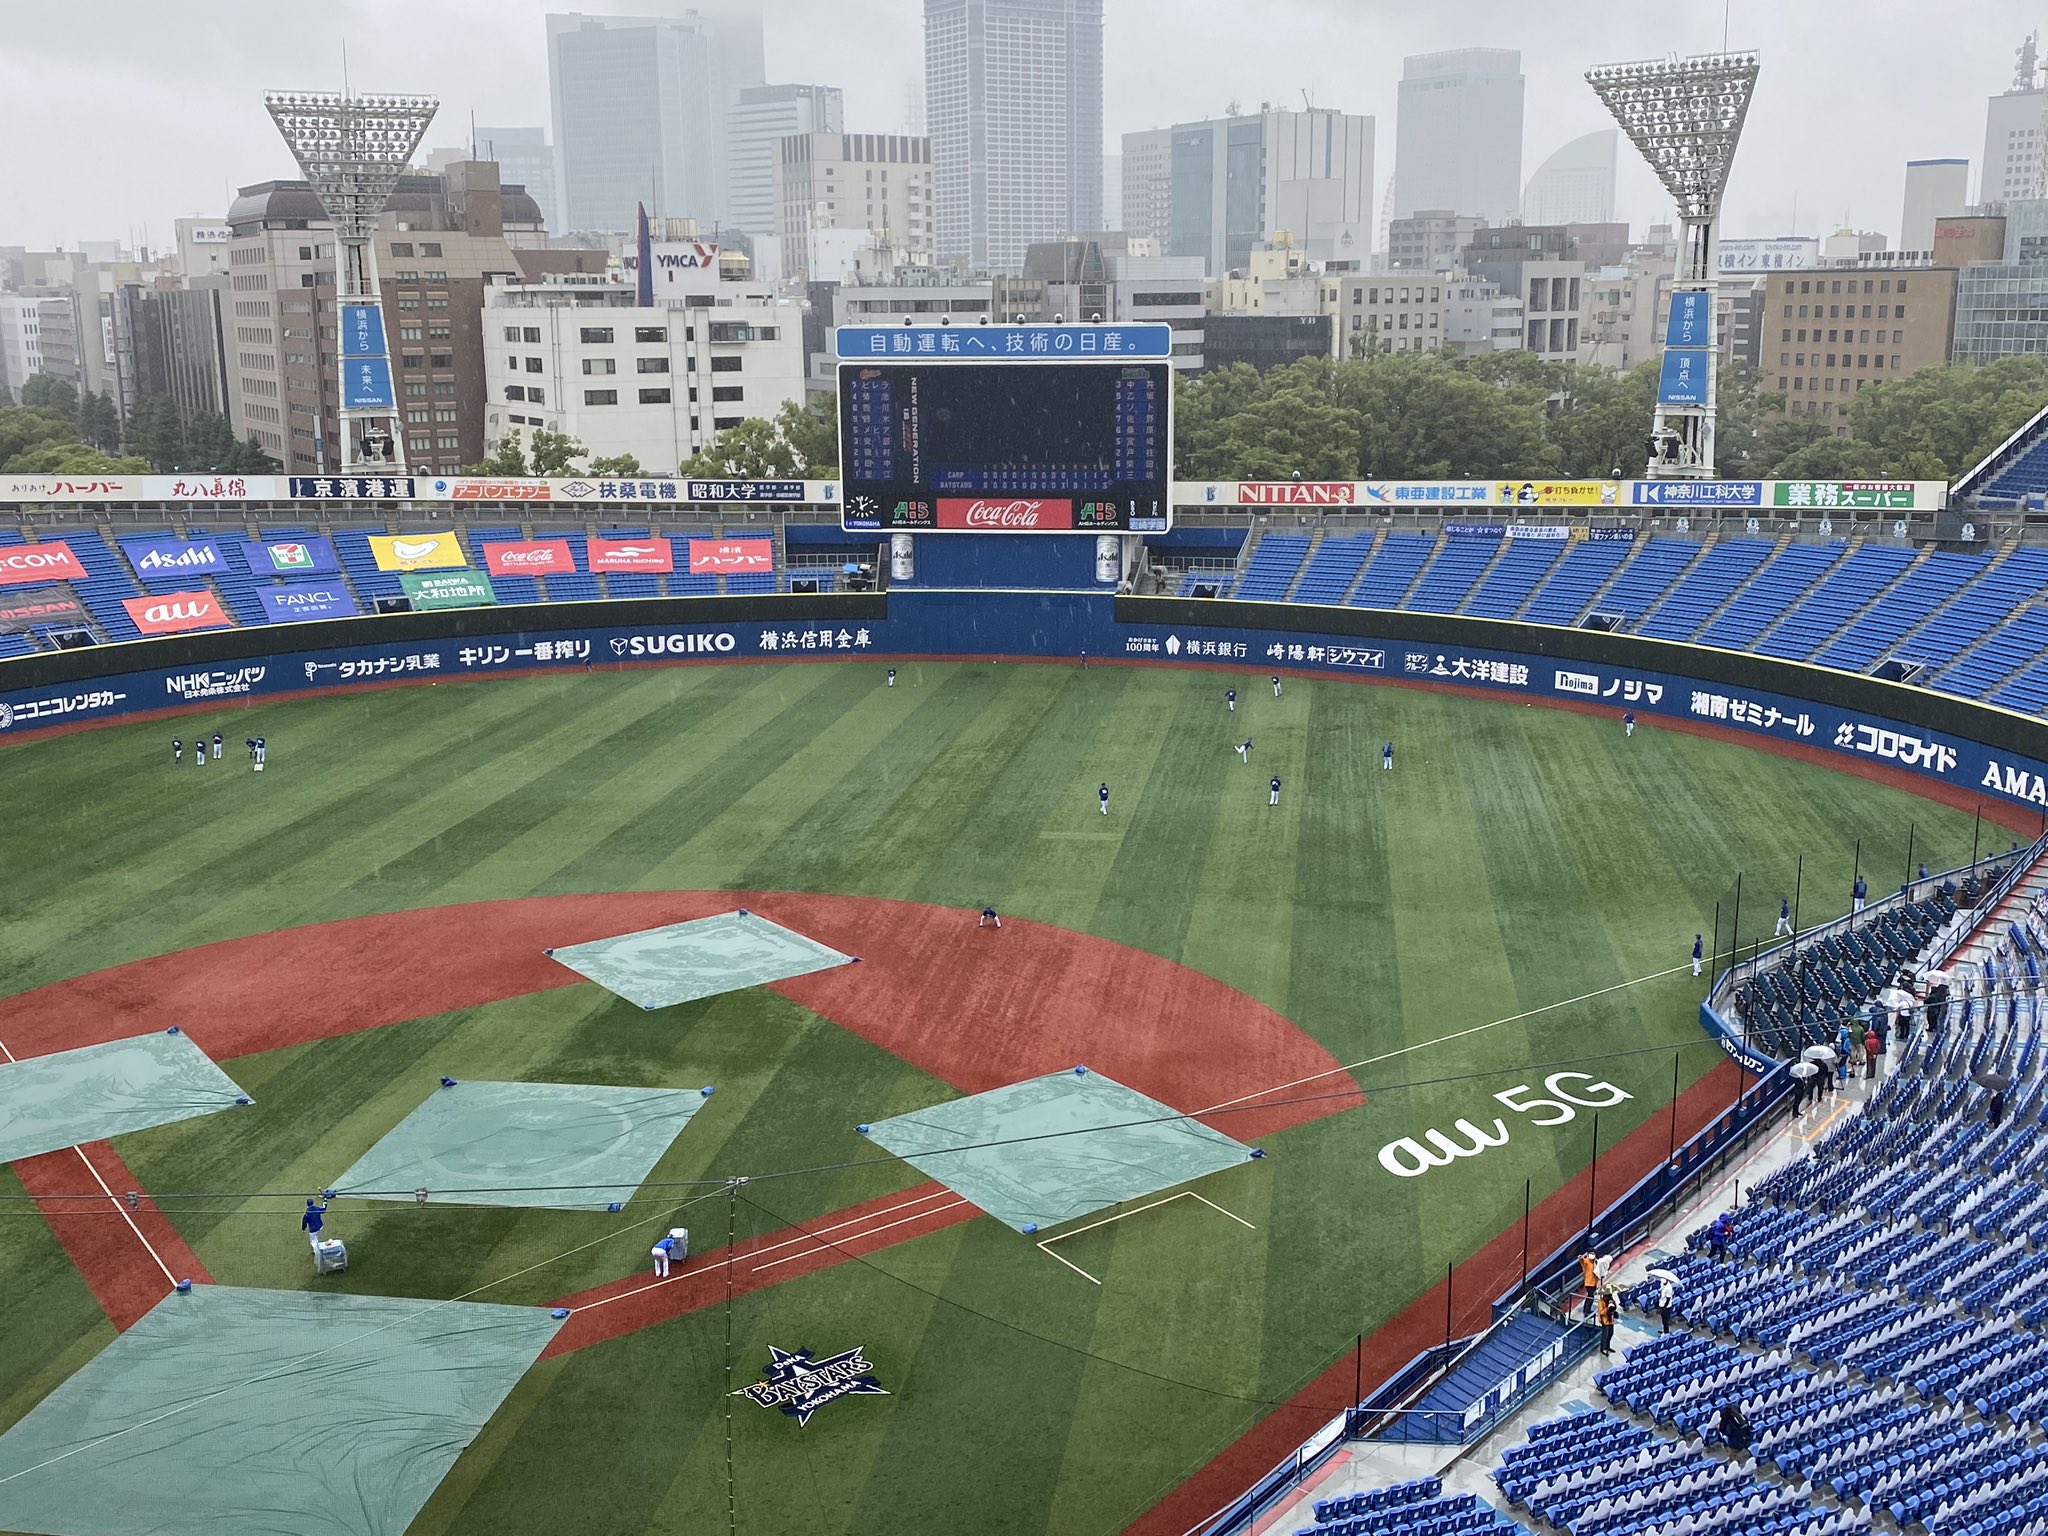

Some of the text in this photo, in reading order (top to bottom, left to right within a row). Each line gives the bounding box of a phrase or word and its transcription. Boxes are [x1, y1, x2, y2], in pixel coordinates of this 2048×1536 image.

[657, 254, 698, 268] YMCA
[356, 309, 369, 351] 横浜から
[1683, 296, 1696, 342] 横浜から
[869, 332, 1138, 352] 自動運転へ、技術の日産。
[361, 364, 373, 392] 未来へ
[1678, 358, 1691, 389] 頂点へ
[911, 407, 920, 484] GENERATION
[11, 482, 123, 495] ありあけ ハーバー
[455, 486, 550, 498] アーバンエナジー
[599, 481, 677, 499] 扶桑電機
[692, 483, 757, 499] 昭和大学
[1240, 485, 1330, 503] NITTAN
[1395, 486, 1487, 500] 東亜建設工業
[1663, 483, 1755, 499] 神奈川工科大学
[1788, 484, 1909, 507] 業務スーパー
[139, 545, 215, 569] Asahi
[274, 591, 340, 605] FANCL
[411, 585, 486, 601] 大和地所
[144, 601, 209, 622] au
[630, 633, 736, 655] SUGIKO
[759, 628, 872, 650] 横浜信用金庫
[1125, 642, 1160, 653] 100周年
[1186, 639, 1248, 658] 横浜銀行
[458, 639, 591, 666] キリン一番搾り
[1266, 642, 1383, 667] 崎陽軒 シウマイ
[1405, 653, 1428, 663] オセアン
[338, 652, 440, 678] タカナシ乳業
[1405, 662, 1428, 673] グループ
[1451, 656, 1529, 686] 大洋建設
[1602, 678, 1664, 705] ノジマ
[12, 690, 127, 721] ニコニコレンタカー
[1690, 690, 1815, 737] 湘南ゼミナール
[1856, 723, 1958, 773] コロワイド
[1981, 760, 2048, 807] AMA
[1377, 1071, 1635, 1178] au 5G
[772, 1354, 806, 1370] DeNA
[743, 1355, 874, 1409] BAYSTARS
[797, 1380, 861, 1411] YOKOHAMA
